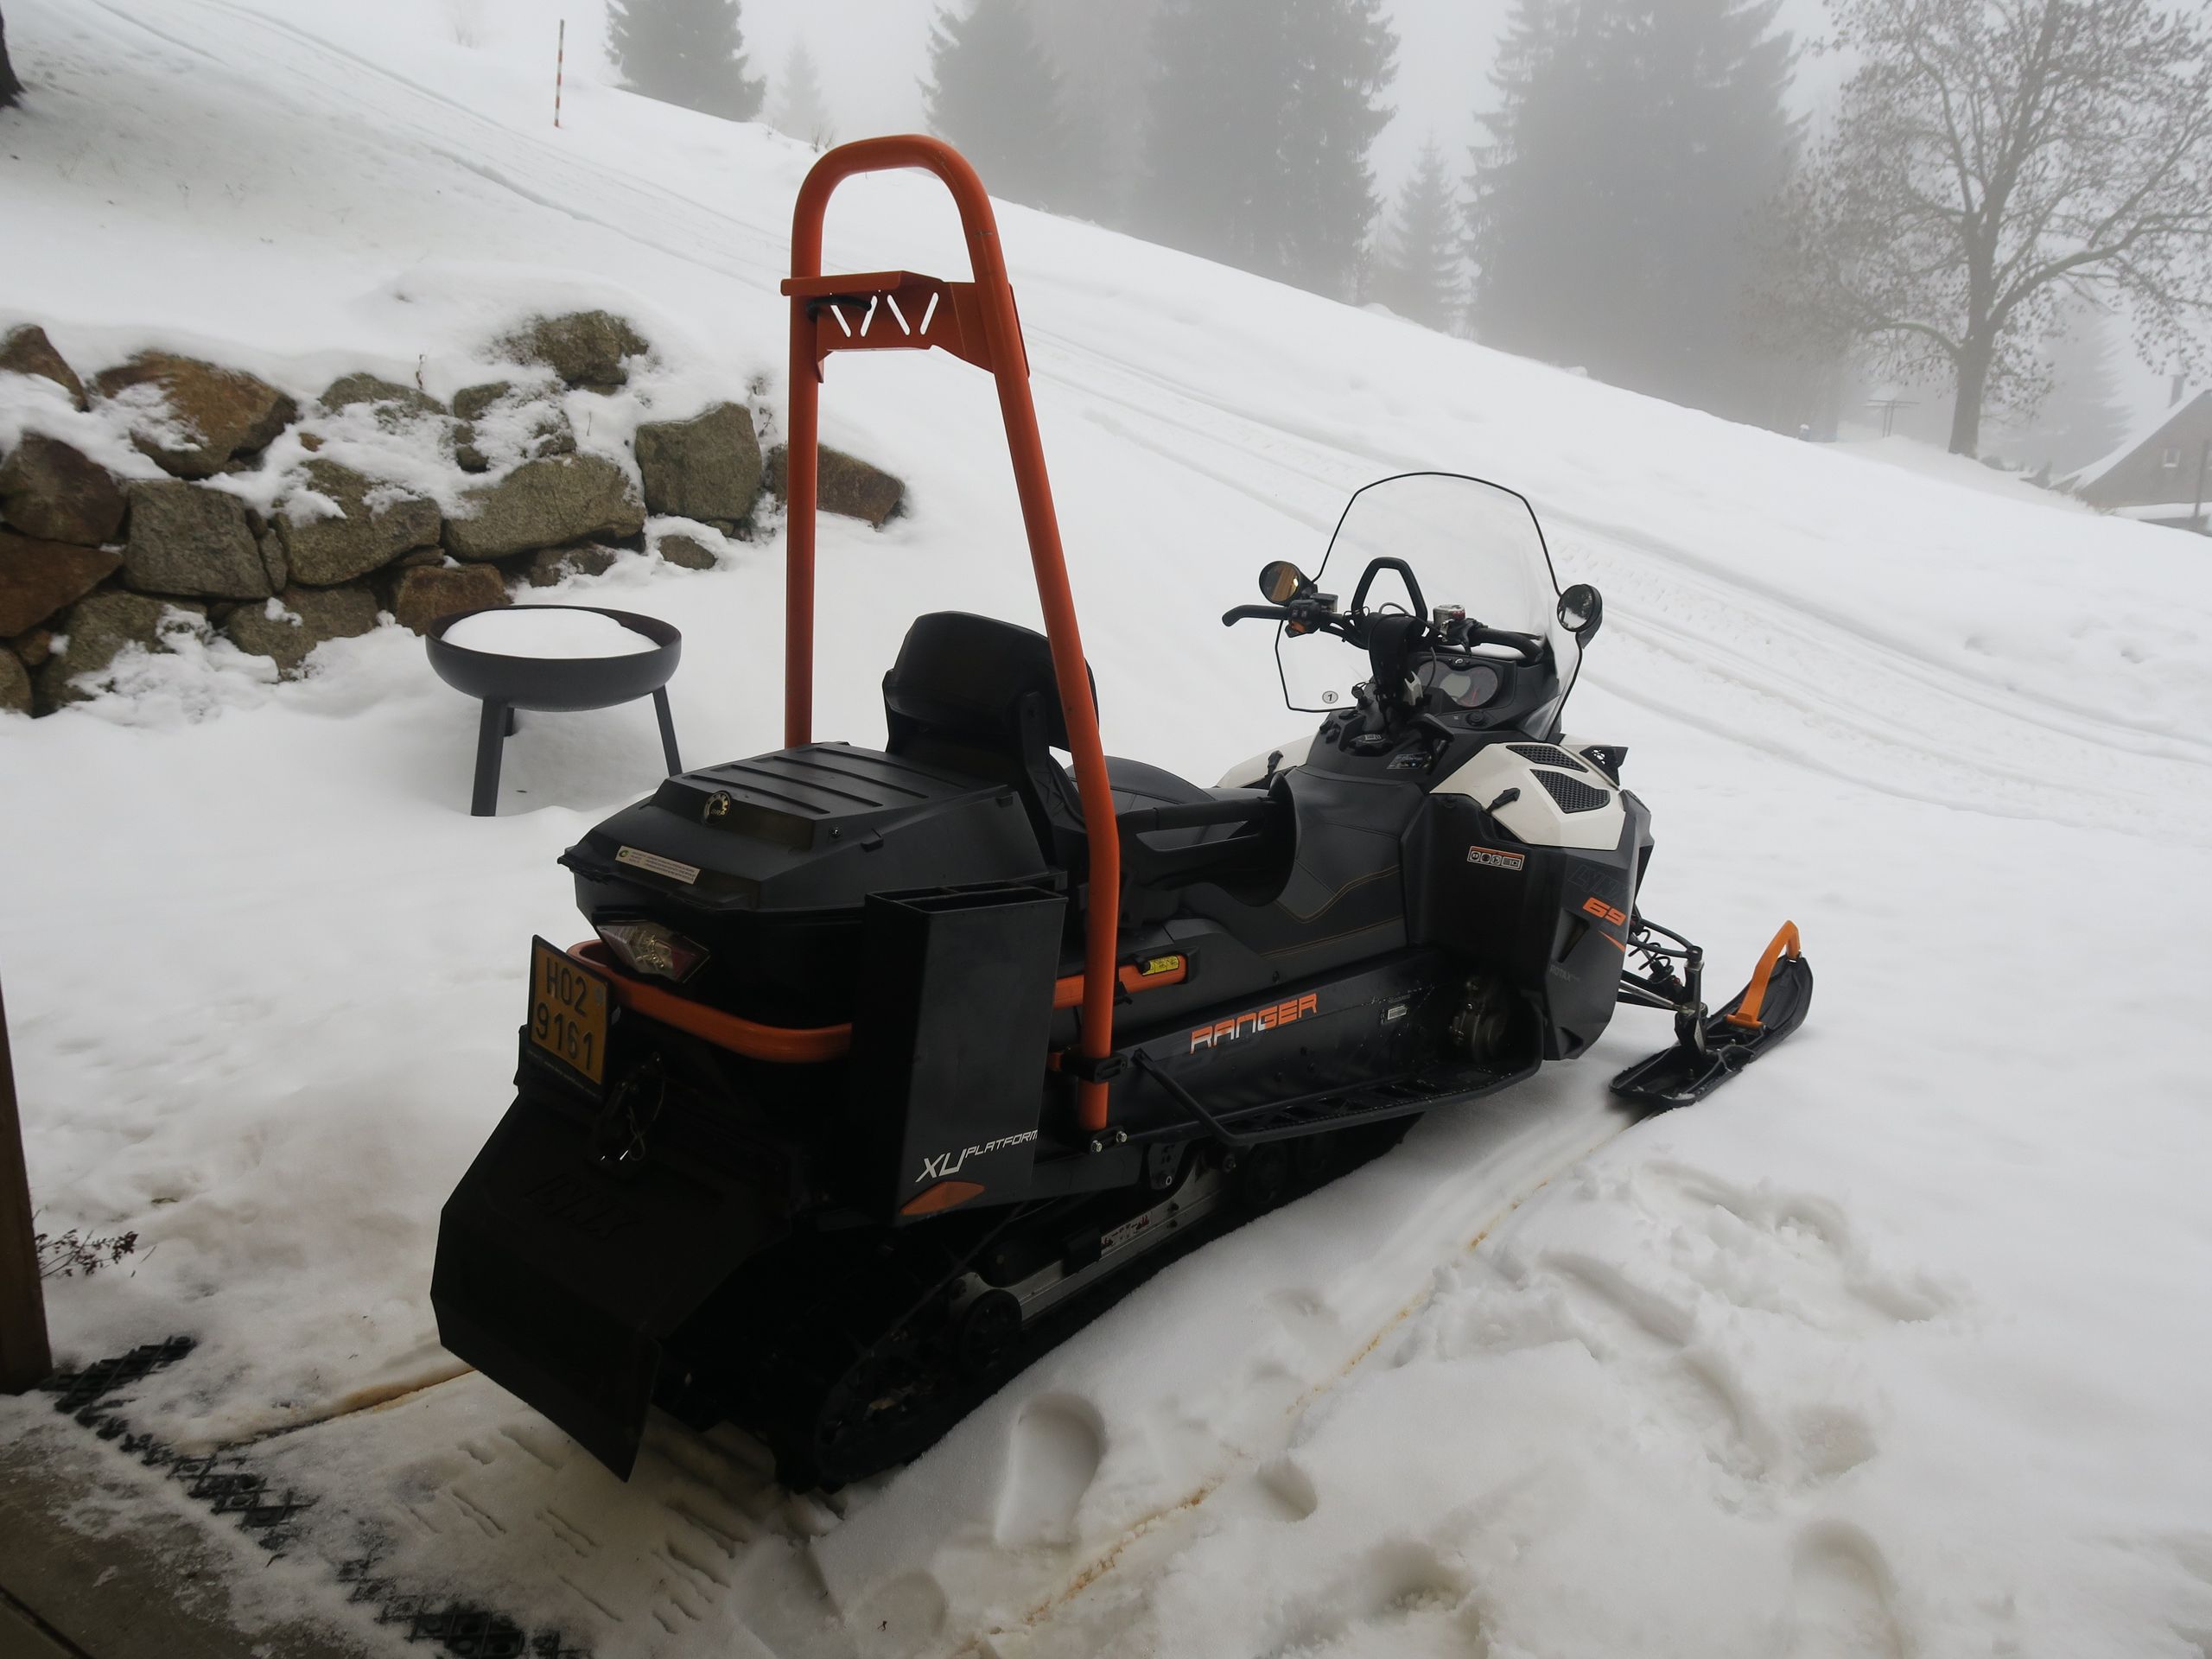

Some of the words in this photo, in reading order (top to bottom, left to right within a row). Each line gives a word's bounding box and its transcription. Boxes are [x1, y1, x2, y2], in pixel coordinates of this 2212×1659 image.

[1582, 896, 1627, 927] 69
[537, 1001, 593, 1071] 9161
[1190, 993, 1318, 1054] RANGER
[915, 1148, 968, 1183] XU
